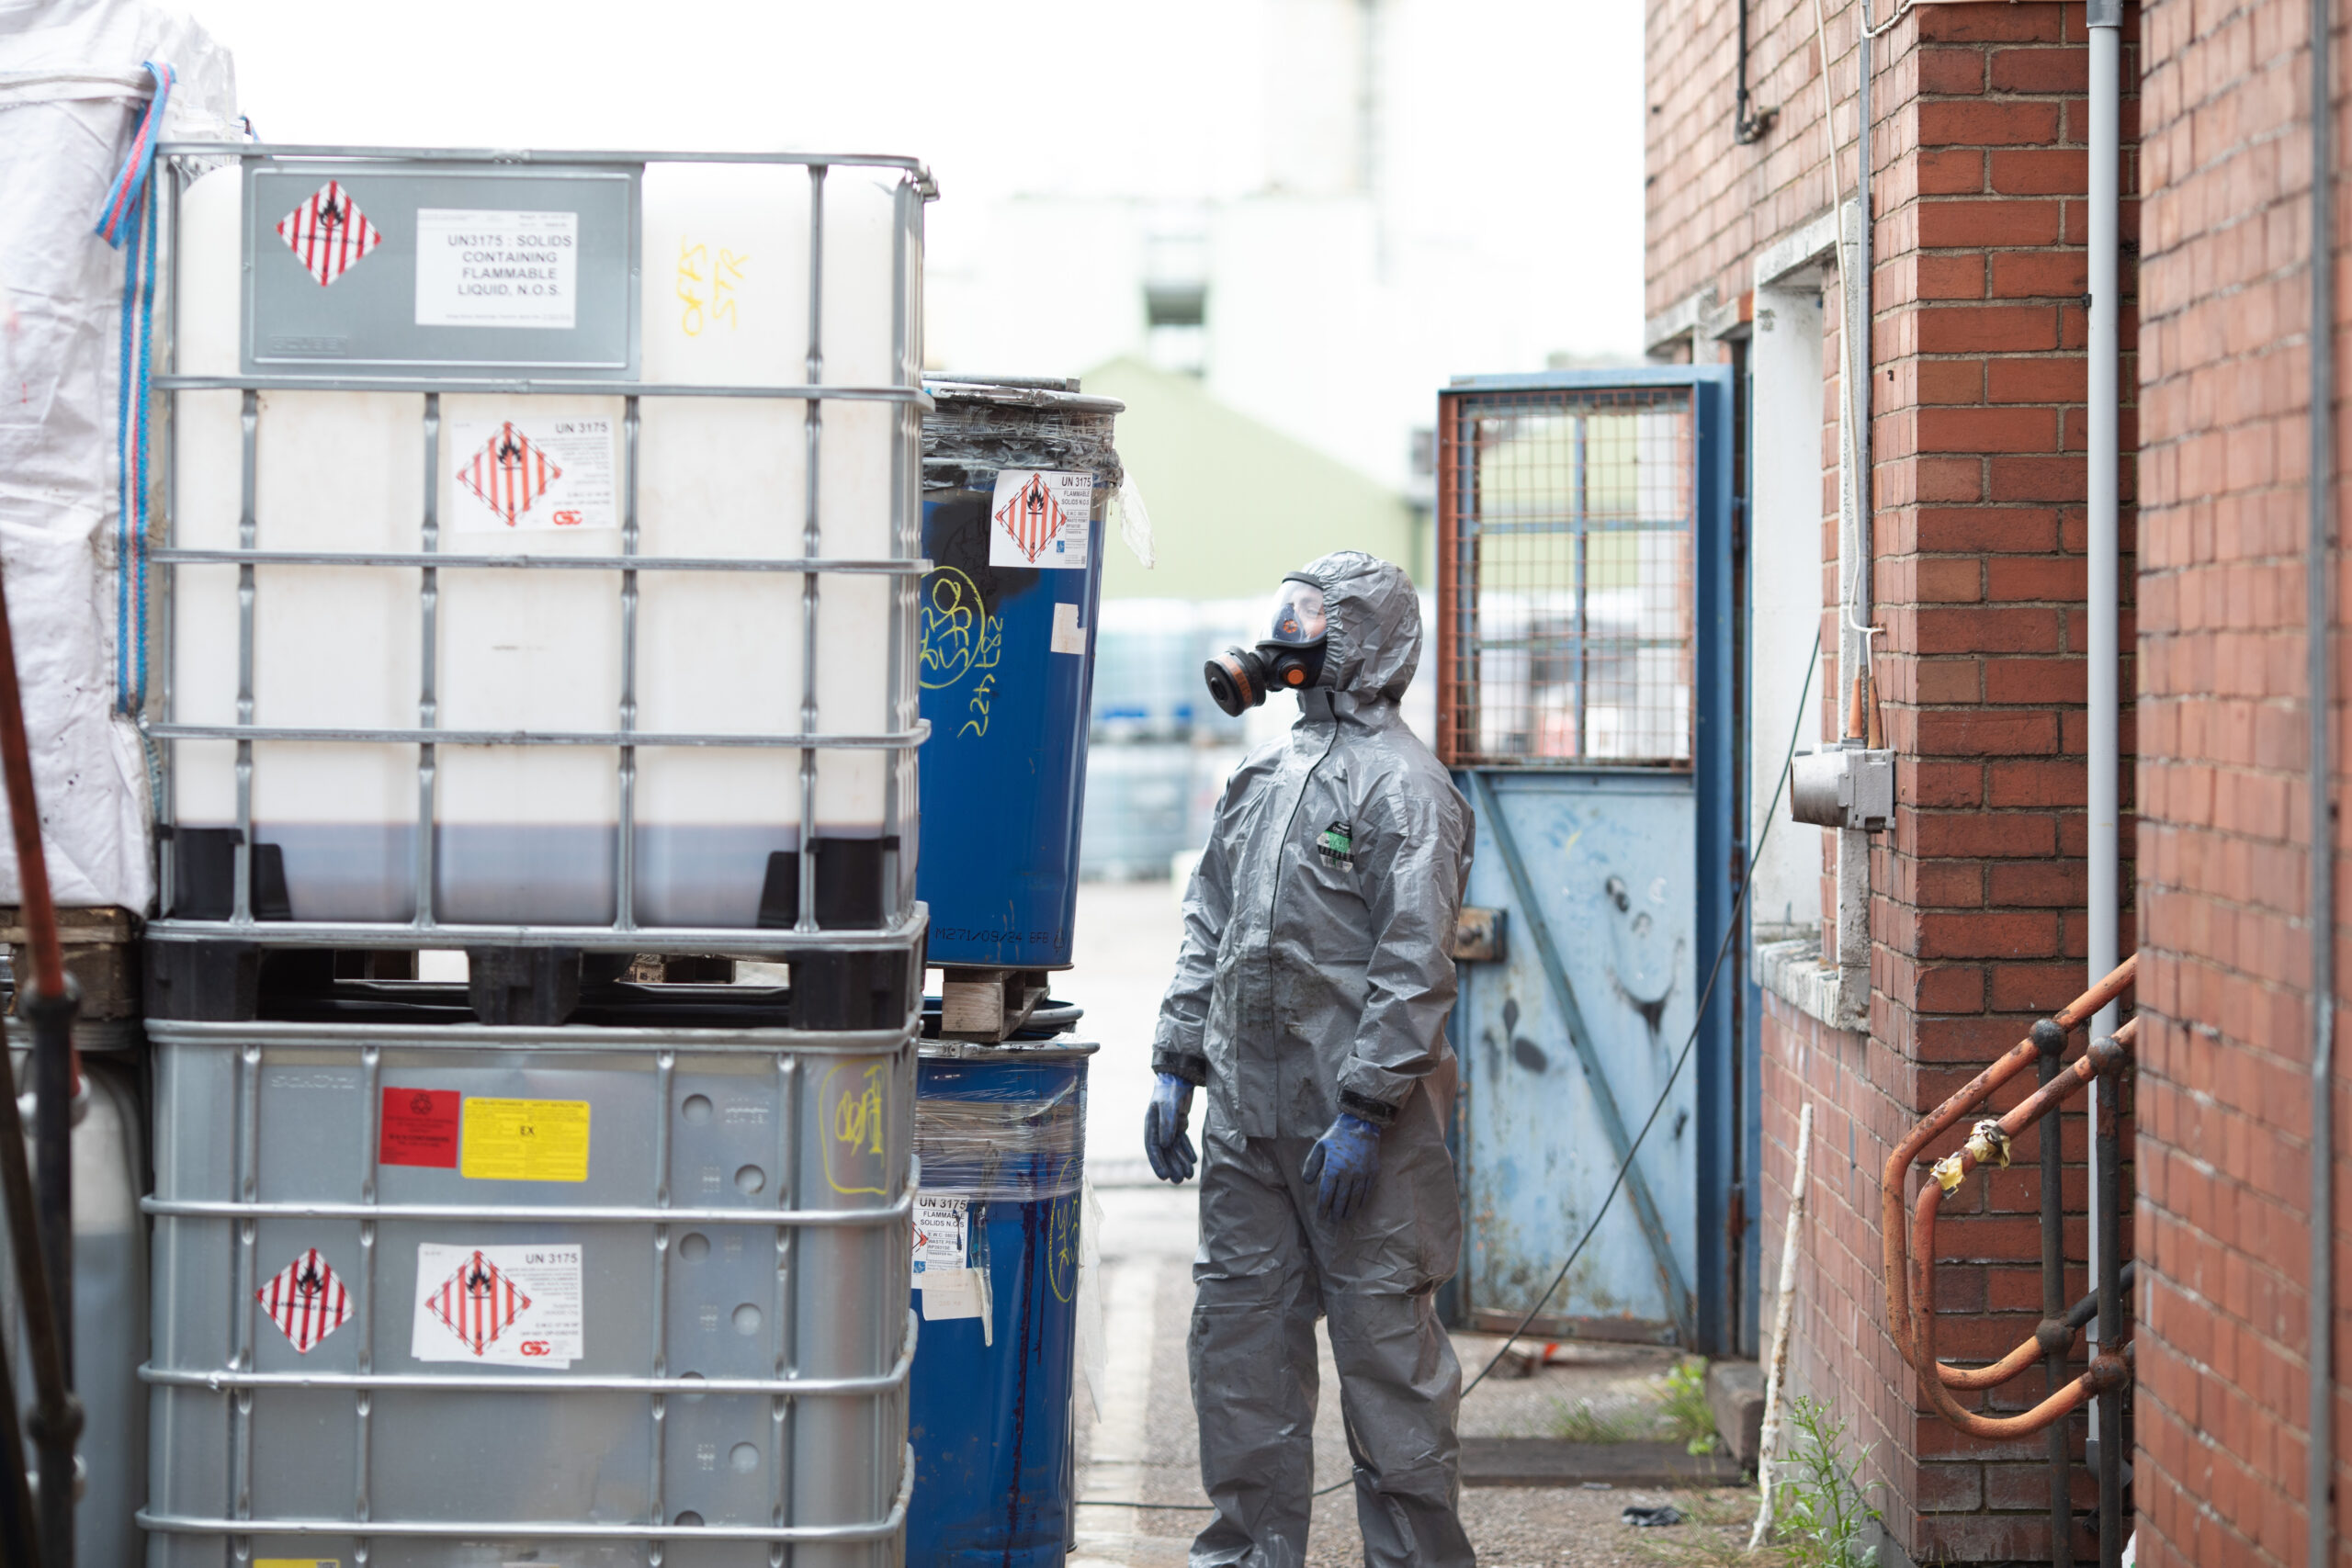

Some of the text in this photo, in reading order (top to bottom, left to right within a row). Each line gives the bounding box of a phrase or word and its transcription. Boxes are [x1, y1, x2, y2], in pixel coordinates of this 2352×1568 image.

[447, 234, 503, 247] UN3175
[516, 235, 572, 247] SOLIDS
[462, 251, 558, 264] CONTAINING
[462, 267, 558, 279] FLAMMABLE
[458, 283, 562, 297] LIQUID, N.O.S.
[555, 422, 608, 434] UN 3175
[1061, 477, 1091, 487] UN 3175
[519, 1124, 536, 1137] EX
[920, 1198, 967, 1210] UN 3175
[922, 1211, 965, 1220] FLAMMABE
[920, 1219, 945, 1227] SOLIDS
[526, 1252, 578, 1264] UN 3175
